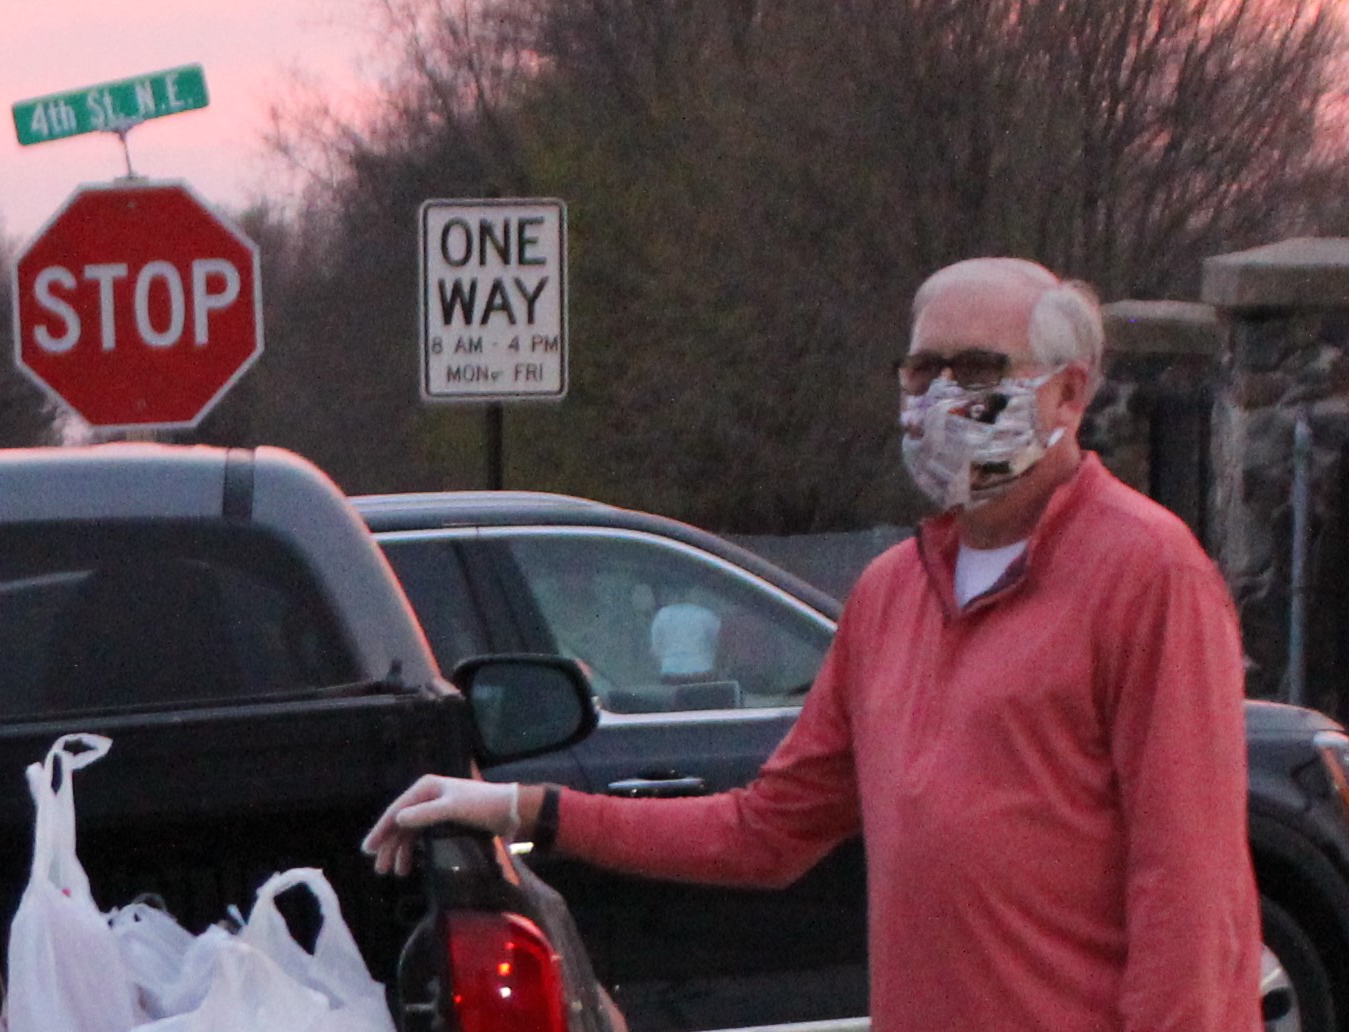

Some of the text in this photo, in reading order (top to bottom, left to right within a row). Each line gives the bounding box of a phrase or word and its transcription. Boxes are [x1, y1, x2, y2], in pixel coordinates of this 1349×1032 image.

[31, 101, 78, 136] 4th
[135, 74, 195, 120] N.E.
[440, 216, 547, 268] ONE
[33, 258, 241, 353] STOP
[437, 276, 549, 326] WAY
[432, 336, 443, 355] 8
[455, 335, 483, 353] AM
[508, 335, 520, 353] 4
[531, 334, 559, 353] PM
[514, 363, 543, 382] FRI
